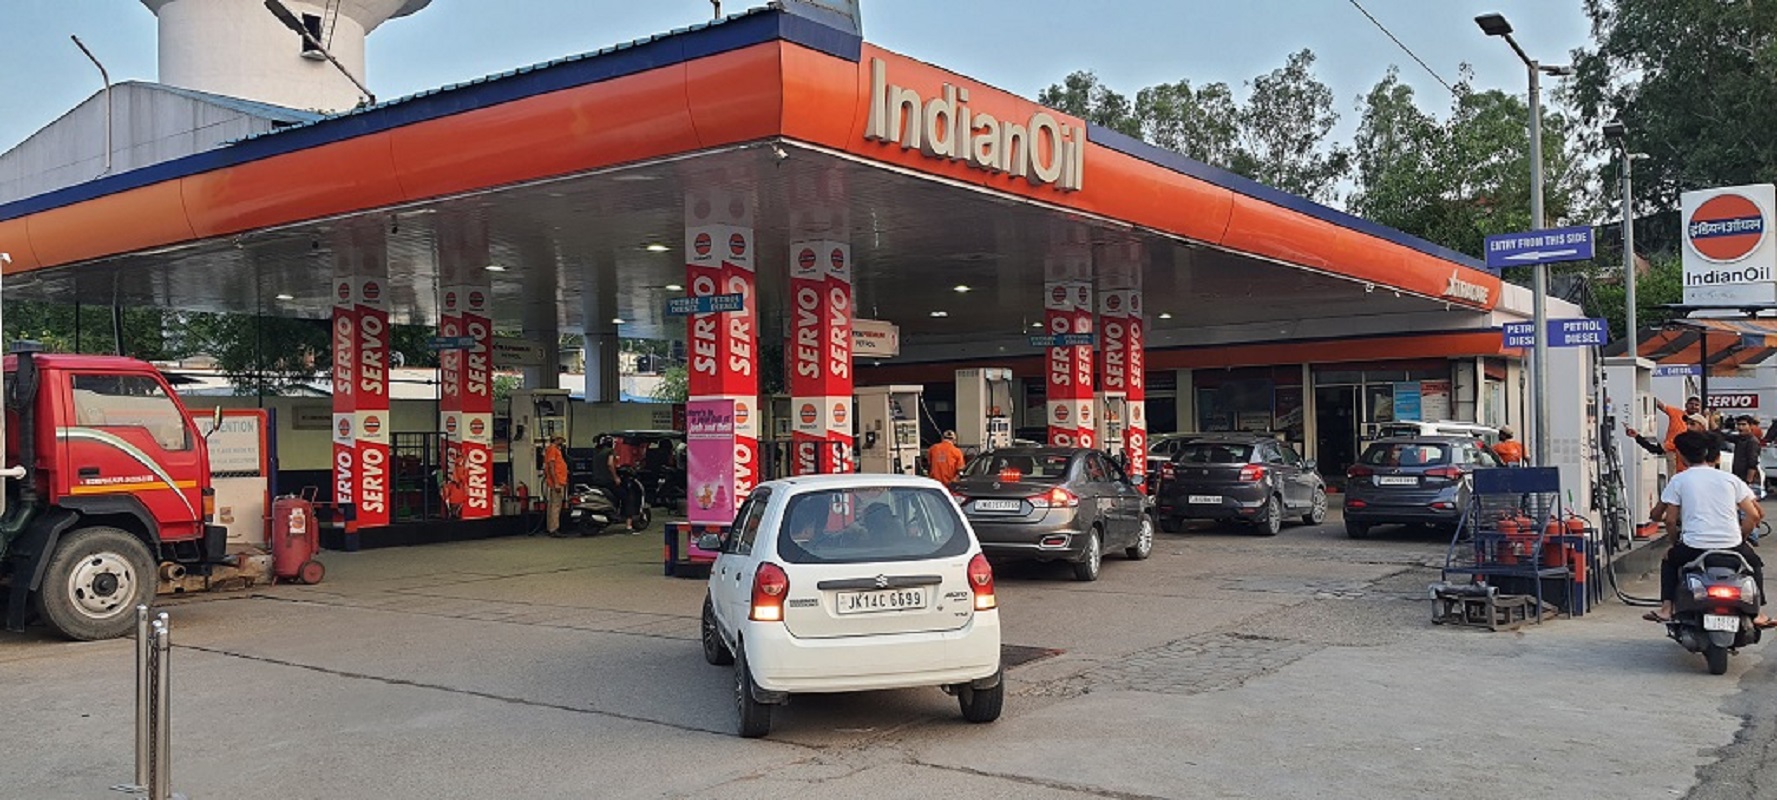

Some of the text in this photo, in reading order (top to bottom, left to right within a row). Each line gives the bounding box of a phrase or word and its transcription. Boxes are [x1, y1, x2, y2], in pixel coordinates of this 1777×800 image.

[864, 57, 1083, 191] IndianOil
[1491, 233, 1587, 251] ENTRY FROM THIS SIDE
[1687, 266, 1769, 285] IndianOil
[337, 316, 351, 395] SERVO
[361, 315, 382, 395] SERVO
[694, 276, 715, 375] SERO
[798, 288, 819, 379] SERVO
[830, 288, 847, 379] SERVO
[1052, 317, 1070, 386] SERO
[1079, 317, 1090, 386] SERO
[1105, 323, 1123, 388] SERVO
[1131, 323, 1141, 389] SERVO
[1508, 325, 1534, 333] PETR
[1510, 337, 1534, 345] DIES
[1564, 321, 1602, 331] PETROL
[1565, 334, 1600, 344] DIESEL
[203, 421, 253, 433] ATENTION
[1707, 396, 1752, 407] SERVO
[338, 452, 352, 503] ERVO
[363, 449, 384, 513] SERVO
[469, 449, 487, 509] SERVO
[849, 592, 920, 609] JK14C 6699
